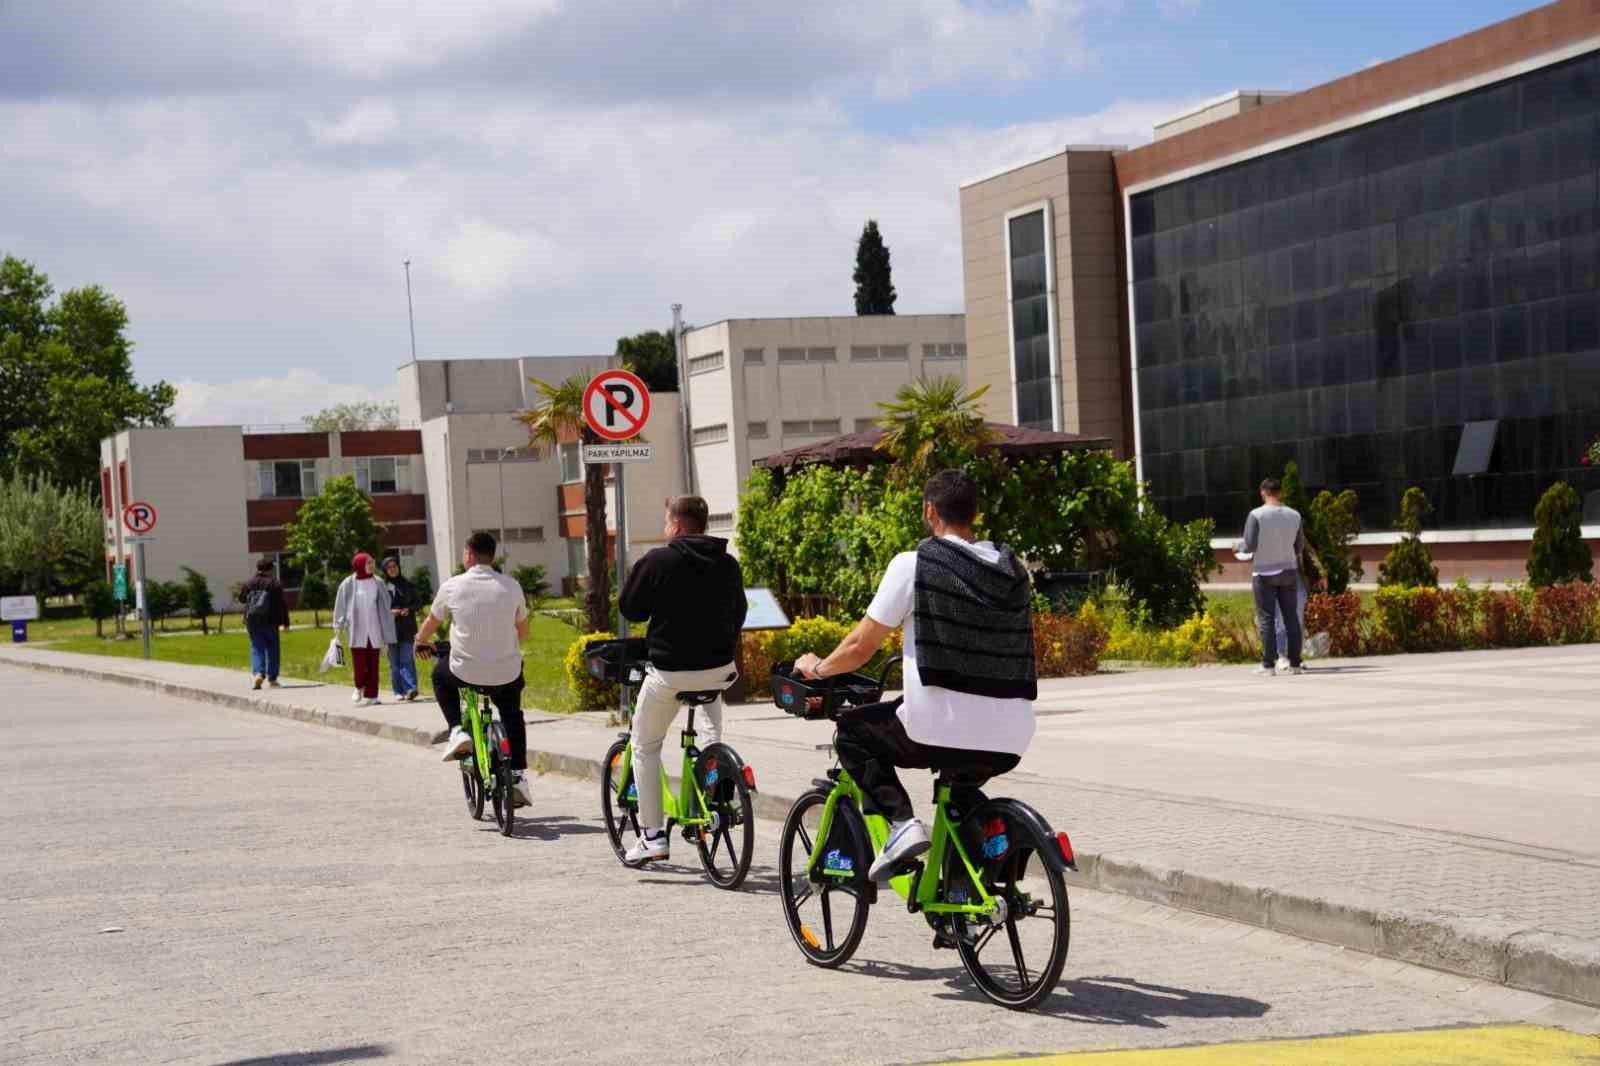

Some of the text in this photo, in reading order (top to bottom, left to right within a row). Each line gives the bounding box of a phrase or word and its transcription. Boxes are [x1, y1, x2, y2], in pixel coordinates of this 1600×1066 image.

[605, 384, 634, 426] P
[588, 447, 649, 457] PARK YAPILMAZ
[134, 508, 148, 527] P
